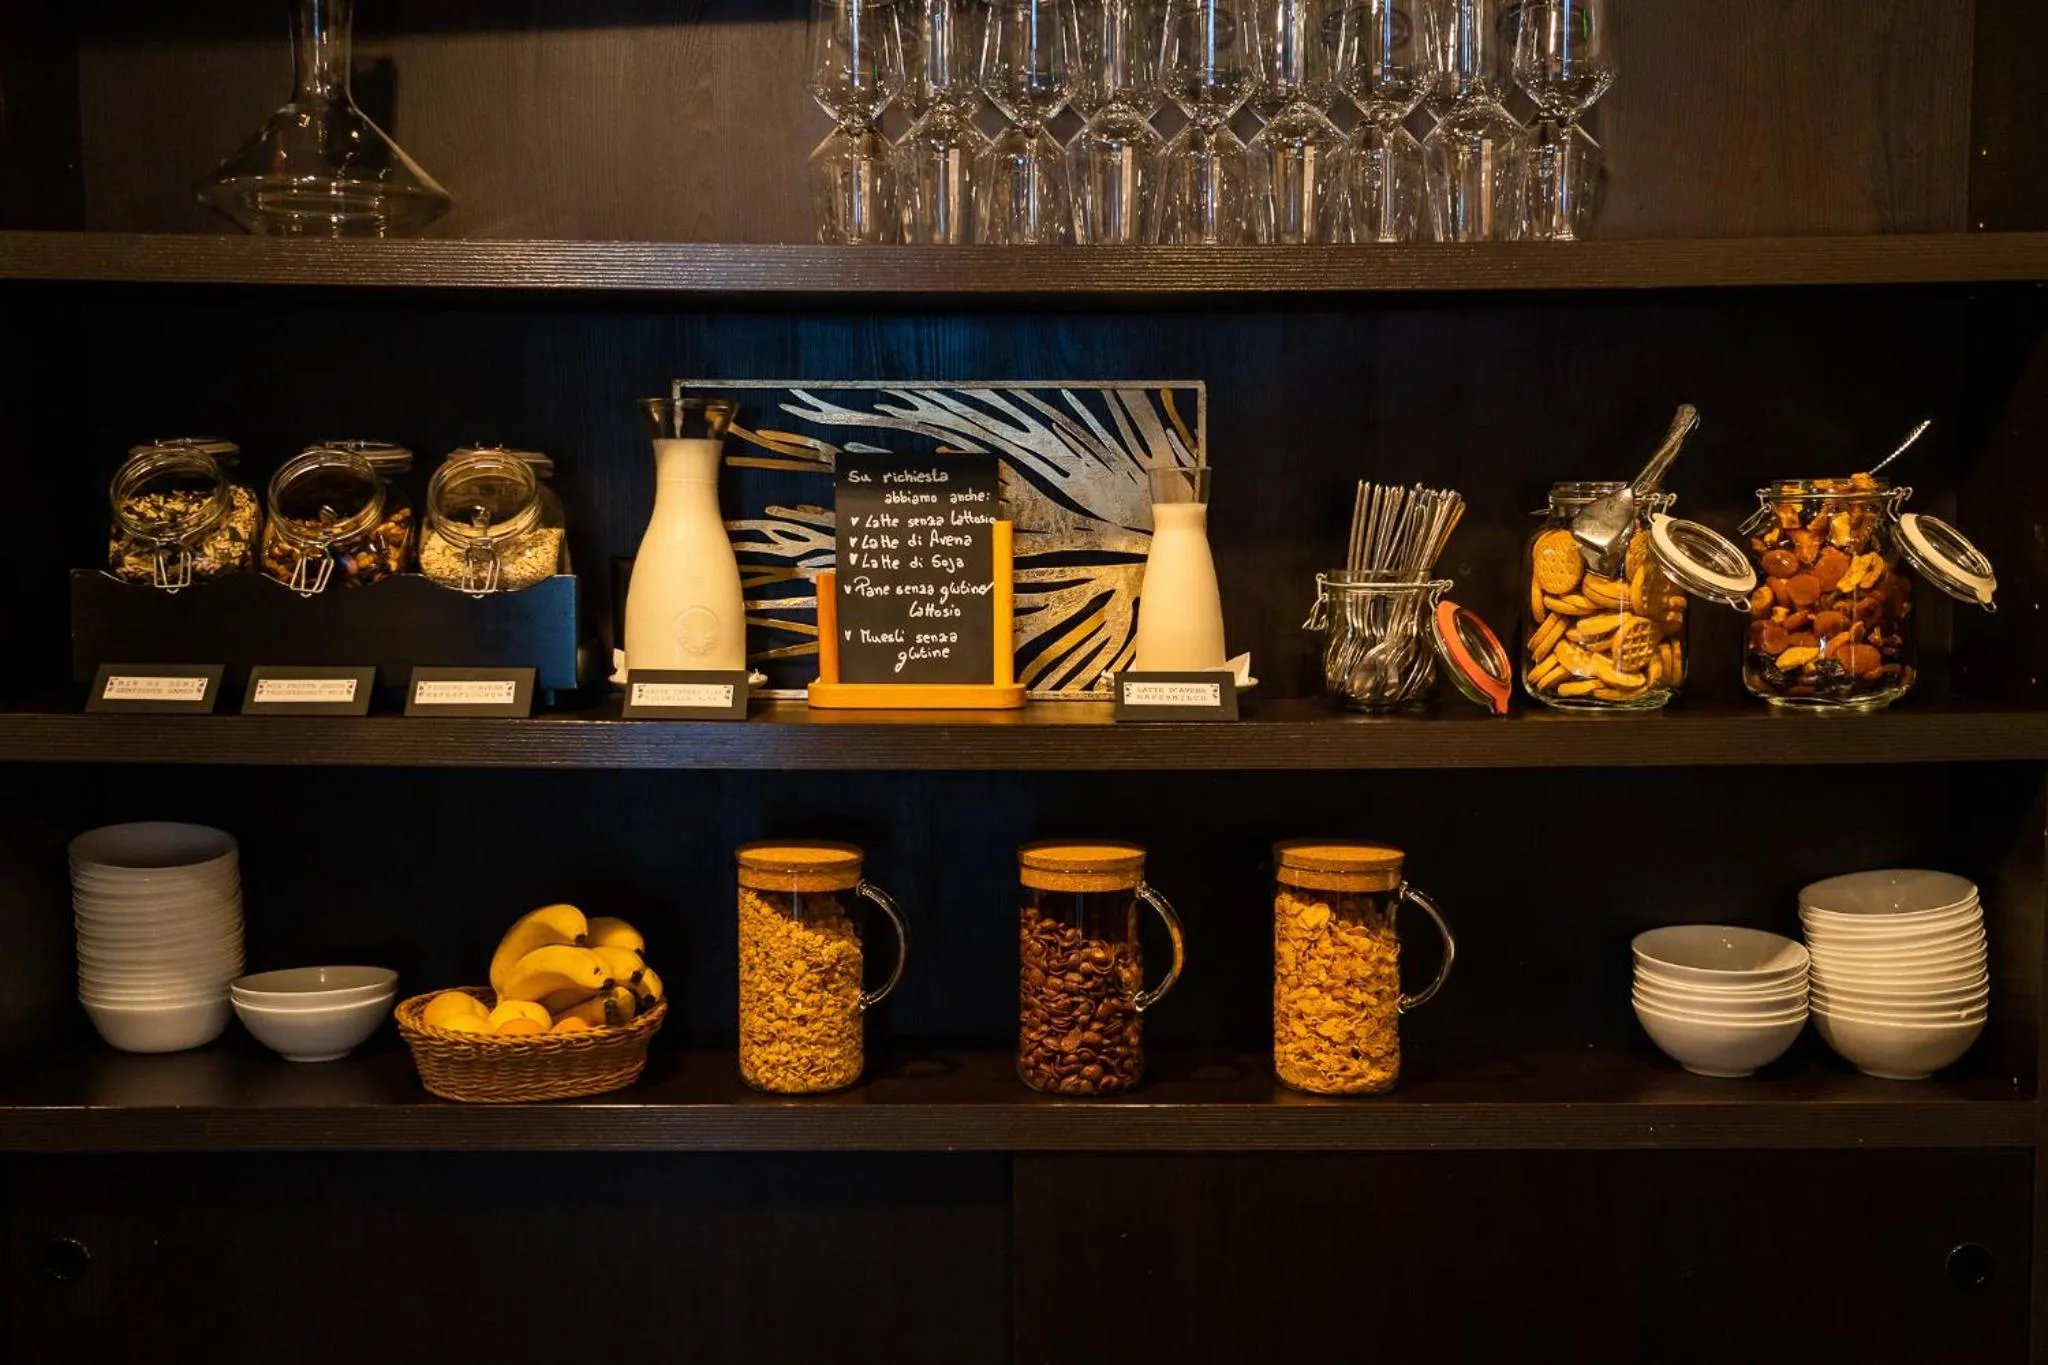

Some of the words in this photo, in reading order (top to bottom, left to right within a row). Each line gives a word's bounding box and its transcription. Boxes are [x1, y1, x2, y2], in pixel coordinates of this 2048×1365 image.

[848, 470, 872, 483] Su
[883, 468, 949, 483] richiesta
[884, 491, 937, 504] abbiamo
[950, 488, 990, 504] anche:
[865, 514, 900, 528] Latte
[908, 516, 944, 527] senza
[862, 535, 899, 549] Latte
[908, 534, 922, 546] di
[929, 530, 972, 548] Avena
[862, 555, 900, 569] Latte
[910, 556, 923, 568] di
[853, 576, 890, 596] Pane
[896, 583, 934, 595] senza
[860, 629, 905, 643] Muesli
[915, 632, 958, 643] senza
[894, 647, 950, 673] glutine
